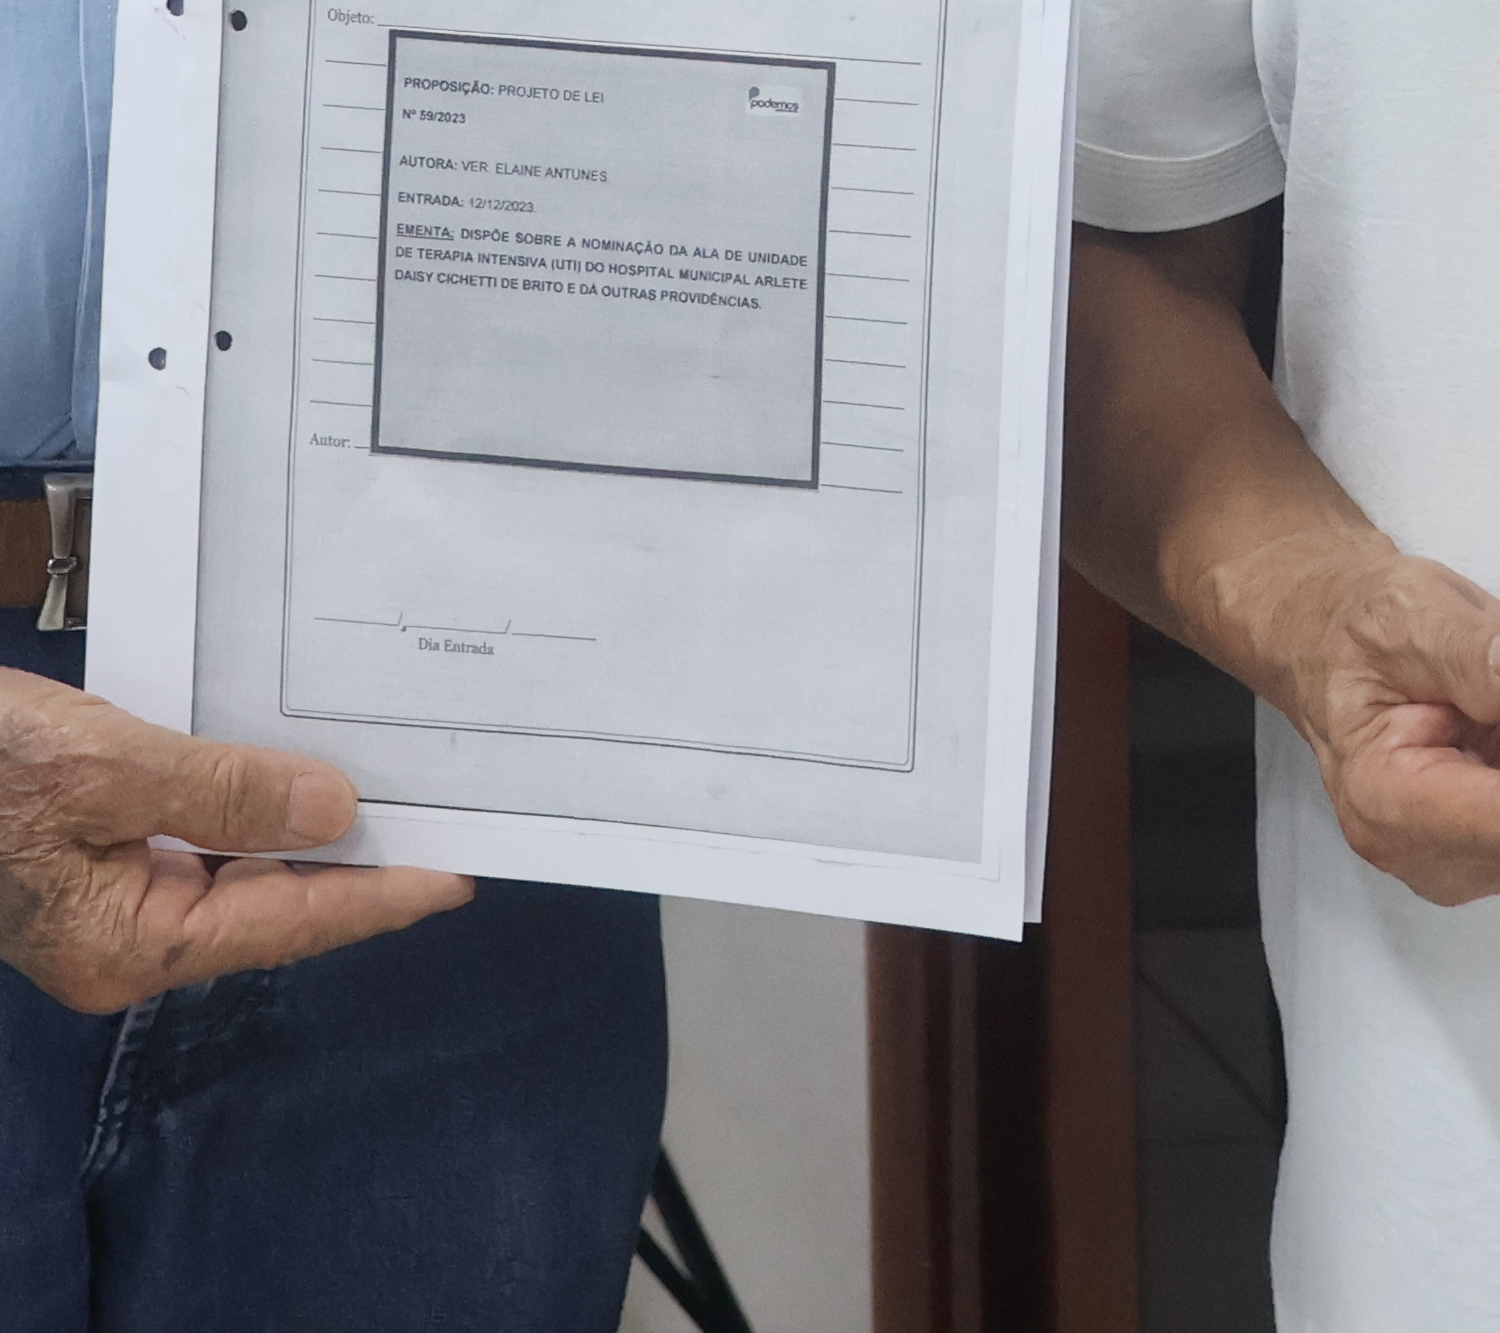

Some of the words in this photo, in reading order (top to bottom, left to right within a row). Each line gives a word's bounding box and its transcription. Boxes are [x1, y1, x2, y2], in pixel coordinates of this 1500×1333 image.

[327, 8, 374, 26] Objeto:
[404, 77, 495, 96] PROPOSIÇÃO:
[498, 85, 560, 100] PROJETO
[563, 90, 581, 101] DE
[585, 91, 604, 103] LEI
[750, 98, 799, 113] podemos
[419, 111, 466, 124] 59/2023
[399, 156, 458, 171] AUTORA:
[495, 163, 542, 177] ELAINE
[545, 167, 608, 183] ANTUNES
[398, 192, 464, 208] ENTRADA:
[397, 223, 455, 239] EMENTA:
[460, 228, 510, 243] DISPÕE
[515, 232, 562, 247] SOBRE
[567, 237, 576, 247] A
[581, 237, 664, 255] NOMINAÇÃO
[669, 244, 688, 256] DA
[693, 248, 720, 260] ALA
[725, 250, 742, 261] DE
[748, 252, 808, 267] UNIDADE
[395, 246, 413, 258] DE
[417, 248, 474, 263] TERAPIA
[478, 253, 547, 269] INTENSIVA
[551, 259, 581, 273] (UTI)
[585, 261, 604, 273] DO
[608, 263, 674, 279] HOSPITAL
[679, 269, 751, 285] MUNICIPAL
[754, 275, 808, 290] ARLETE
[395, 269, 434, 283] DAISY
[437, 272, 497, 288] CICHETTI
[501, 277, 519, 289] DE
[522, 279, 563, 293] BRITO
[567, 283, 576, 294] E
[601, 285, 657, 301] OUTRAS
[660, 290, 762, 310] PROVIDÊNCIAS.
[419, 637, 440, 651] Dia
[444, 639, 494, 655] Entrada
